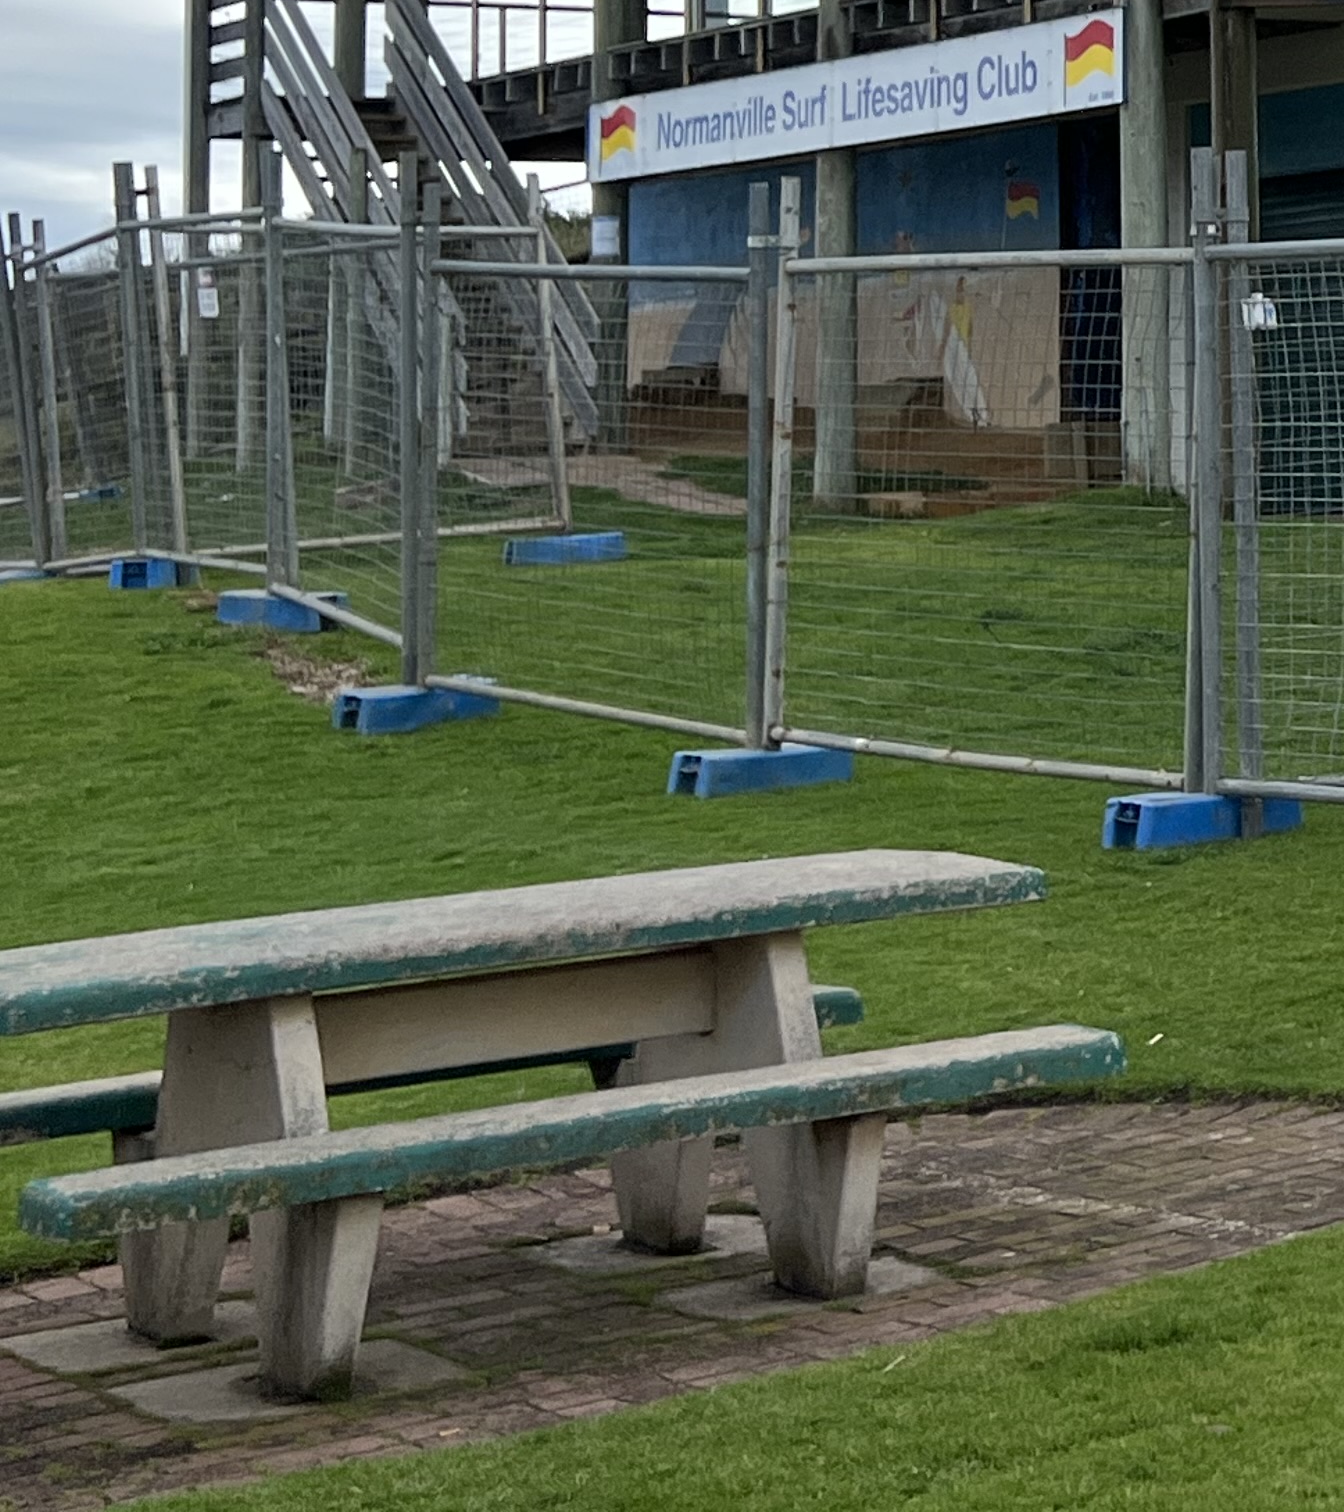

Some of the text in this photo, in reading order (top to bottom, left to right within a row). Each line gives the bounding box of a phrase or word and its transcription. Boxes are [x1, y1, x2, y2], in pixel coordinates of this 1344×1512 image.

[656, 50, 1038, 151] Normanville Surf Lifesaving Club
